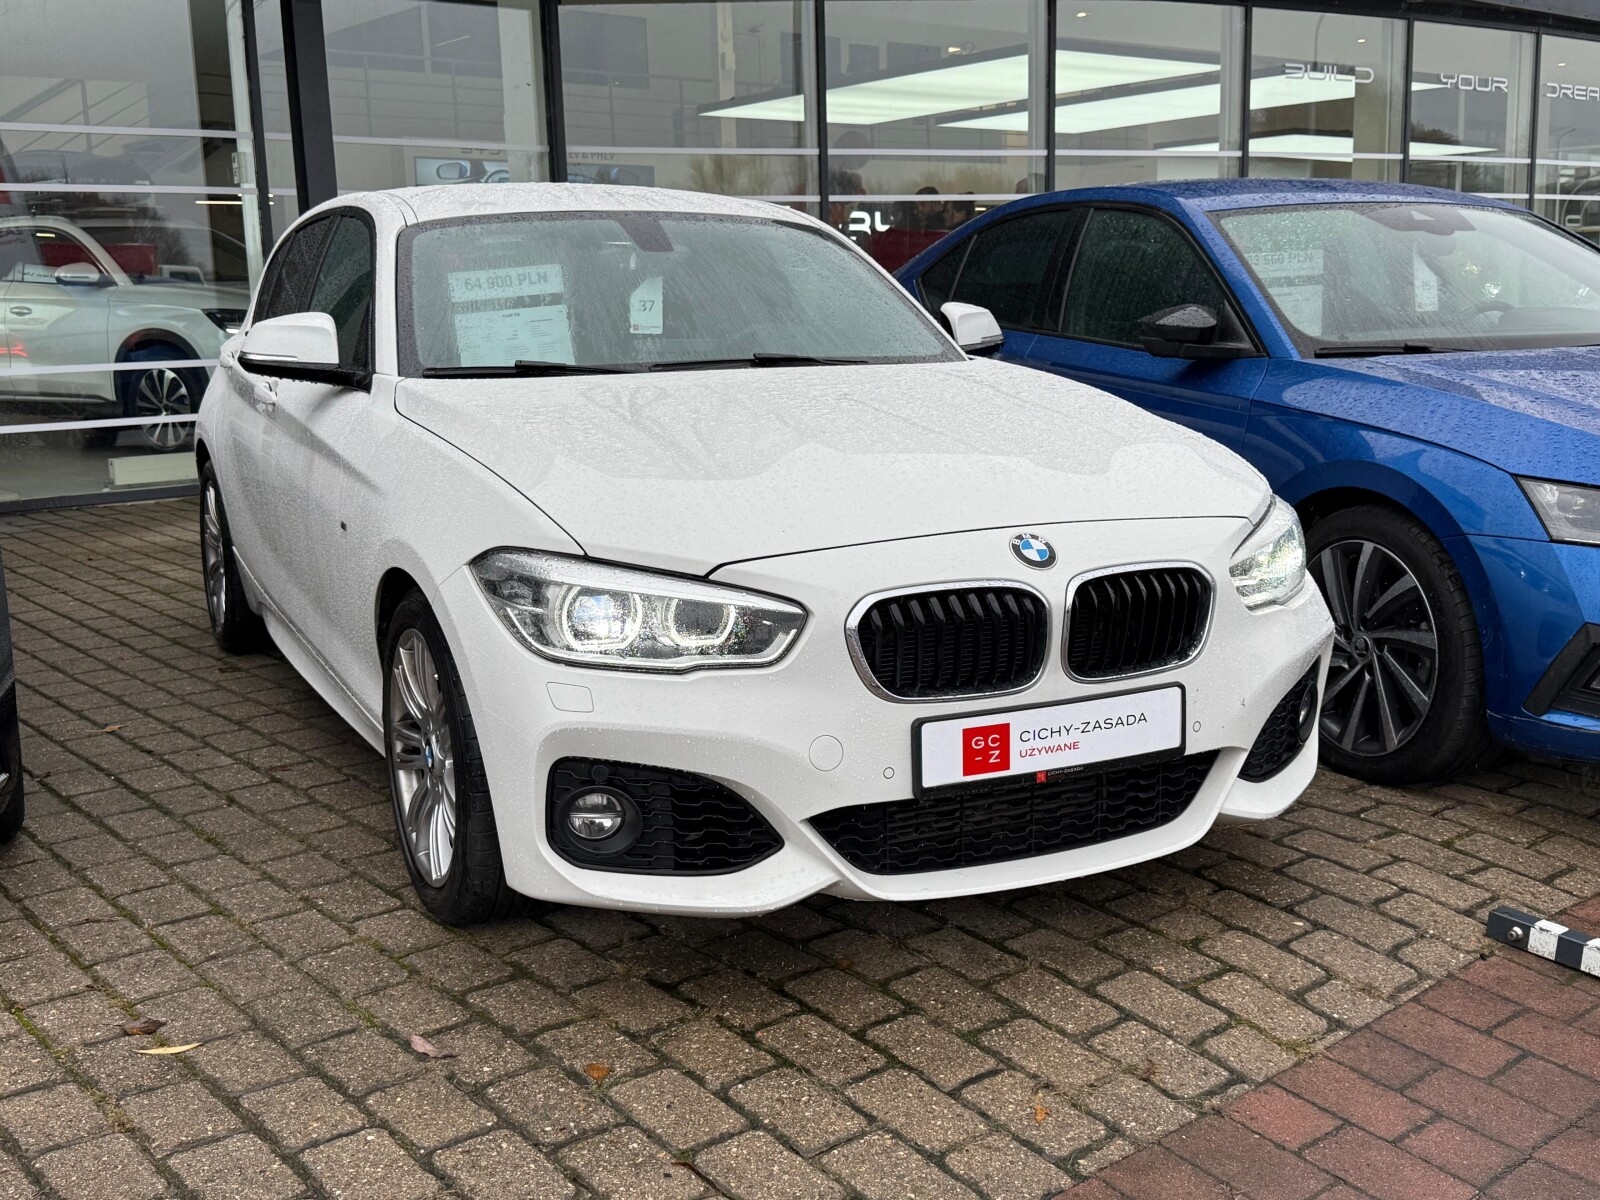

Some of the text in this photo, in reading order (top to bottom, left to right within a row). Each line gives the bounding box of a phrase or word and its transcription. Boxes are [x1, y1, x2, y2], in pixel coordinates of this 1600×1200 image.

[1285, 62, 1374, 84] BUILD
[1440, 72, 1508, 93] YOUR
[464, 271, 549, 292] 64 900 PLN
[639, 299, 655, 312] 37
[1012, 533, 1047, 546] BMW
[1019, 712, 1148, 743] CICHY-ZASADA
[1019, 741, 1081, 759] UŻYWANE
